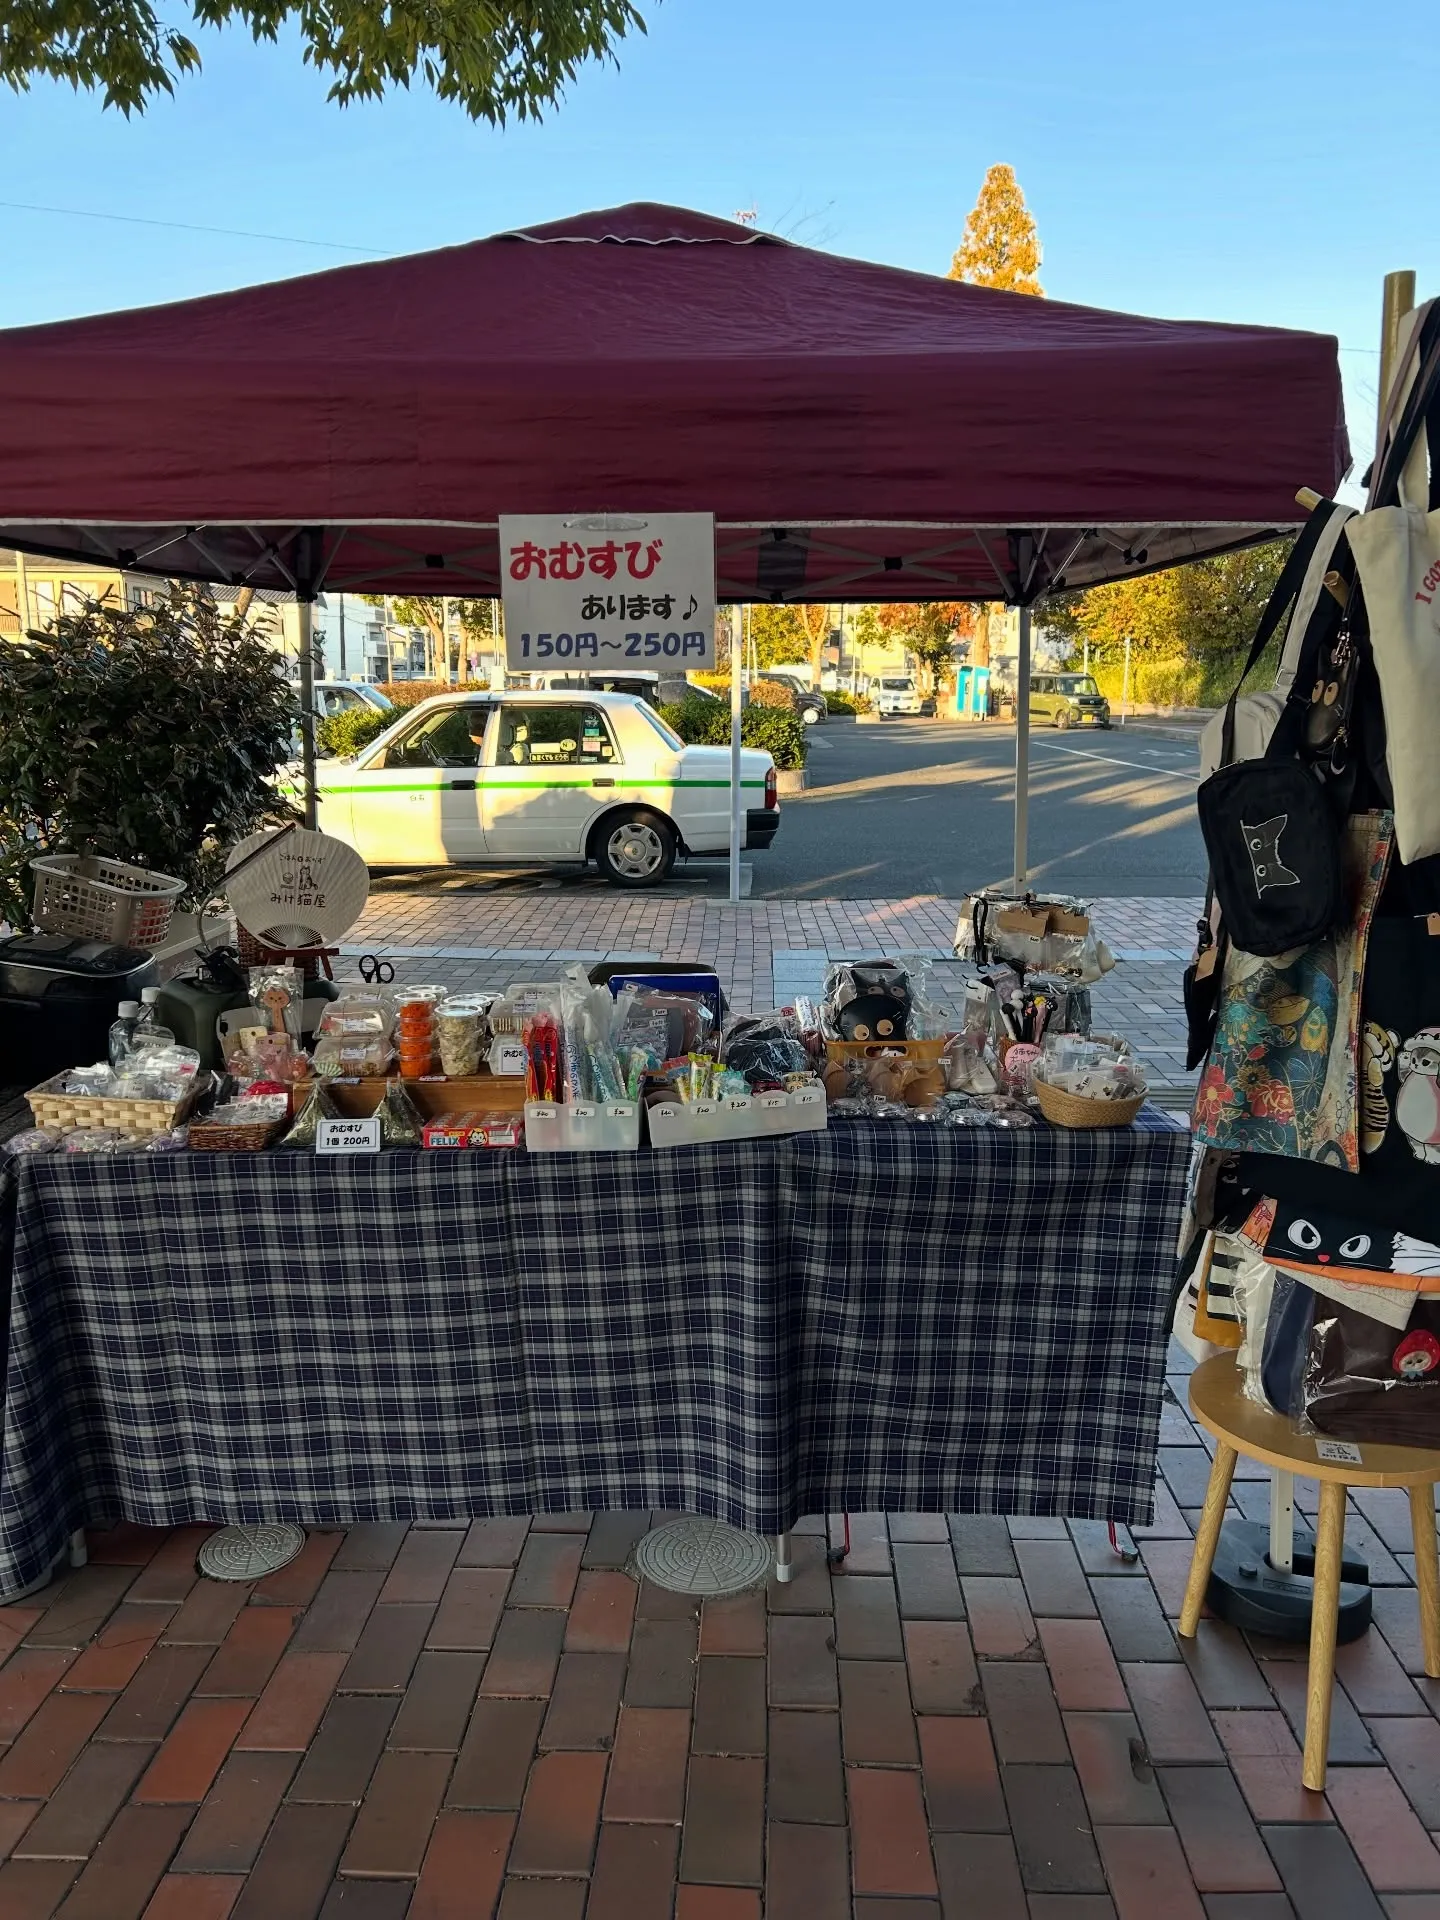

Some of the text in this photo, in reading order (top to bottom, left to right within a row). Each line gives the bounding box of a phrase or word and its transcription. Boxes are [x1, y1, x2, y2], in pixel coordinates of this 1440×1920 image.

[509, 538, 664, 581] おむすび
[270, 892, 327, 908] みけ猫屋
[730, 1101, 747, 1110] ¥20
[330, 1124, 363, 1133] おむすび
[343, 1136, 370, 1145] 200円
[430, 1136, 460, 1146] FELIX
